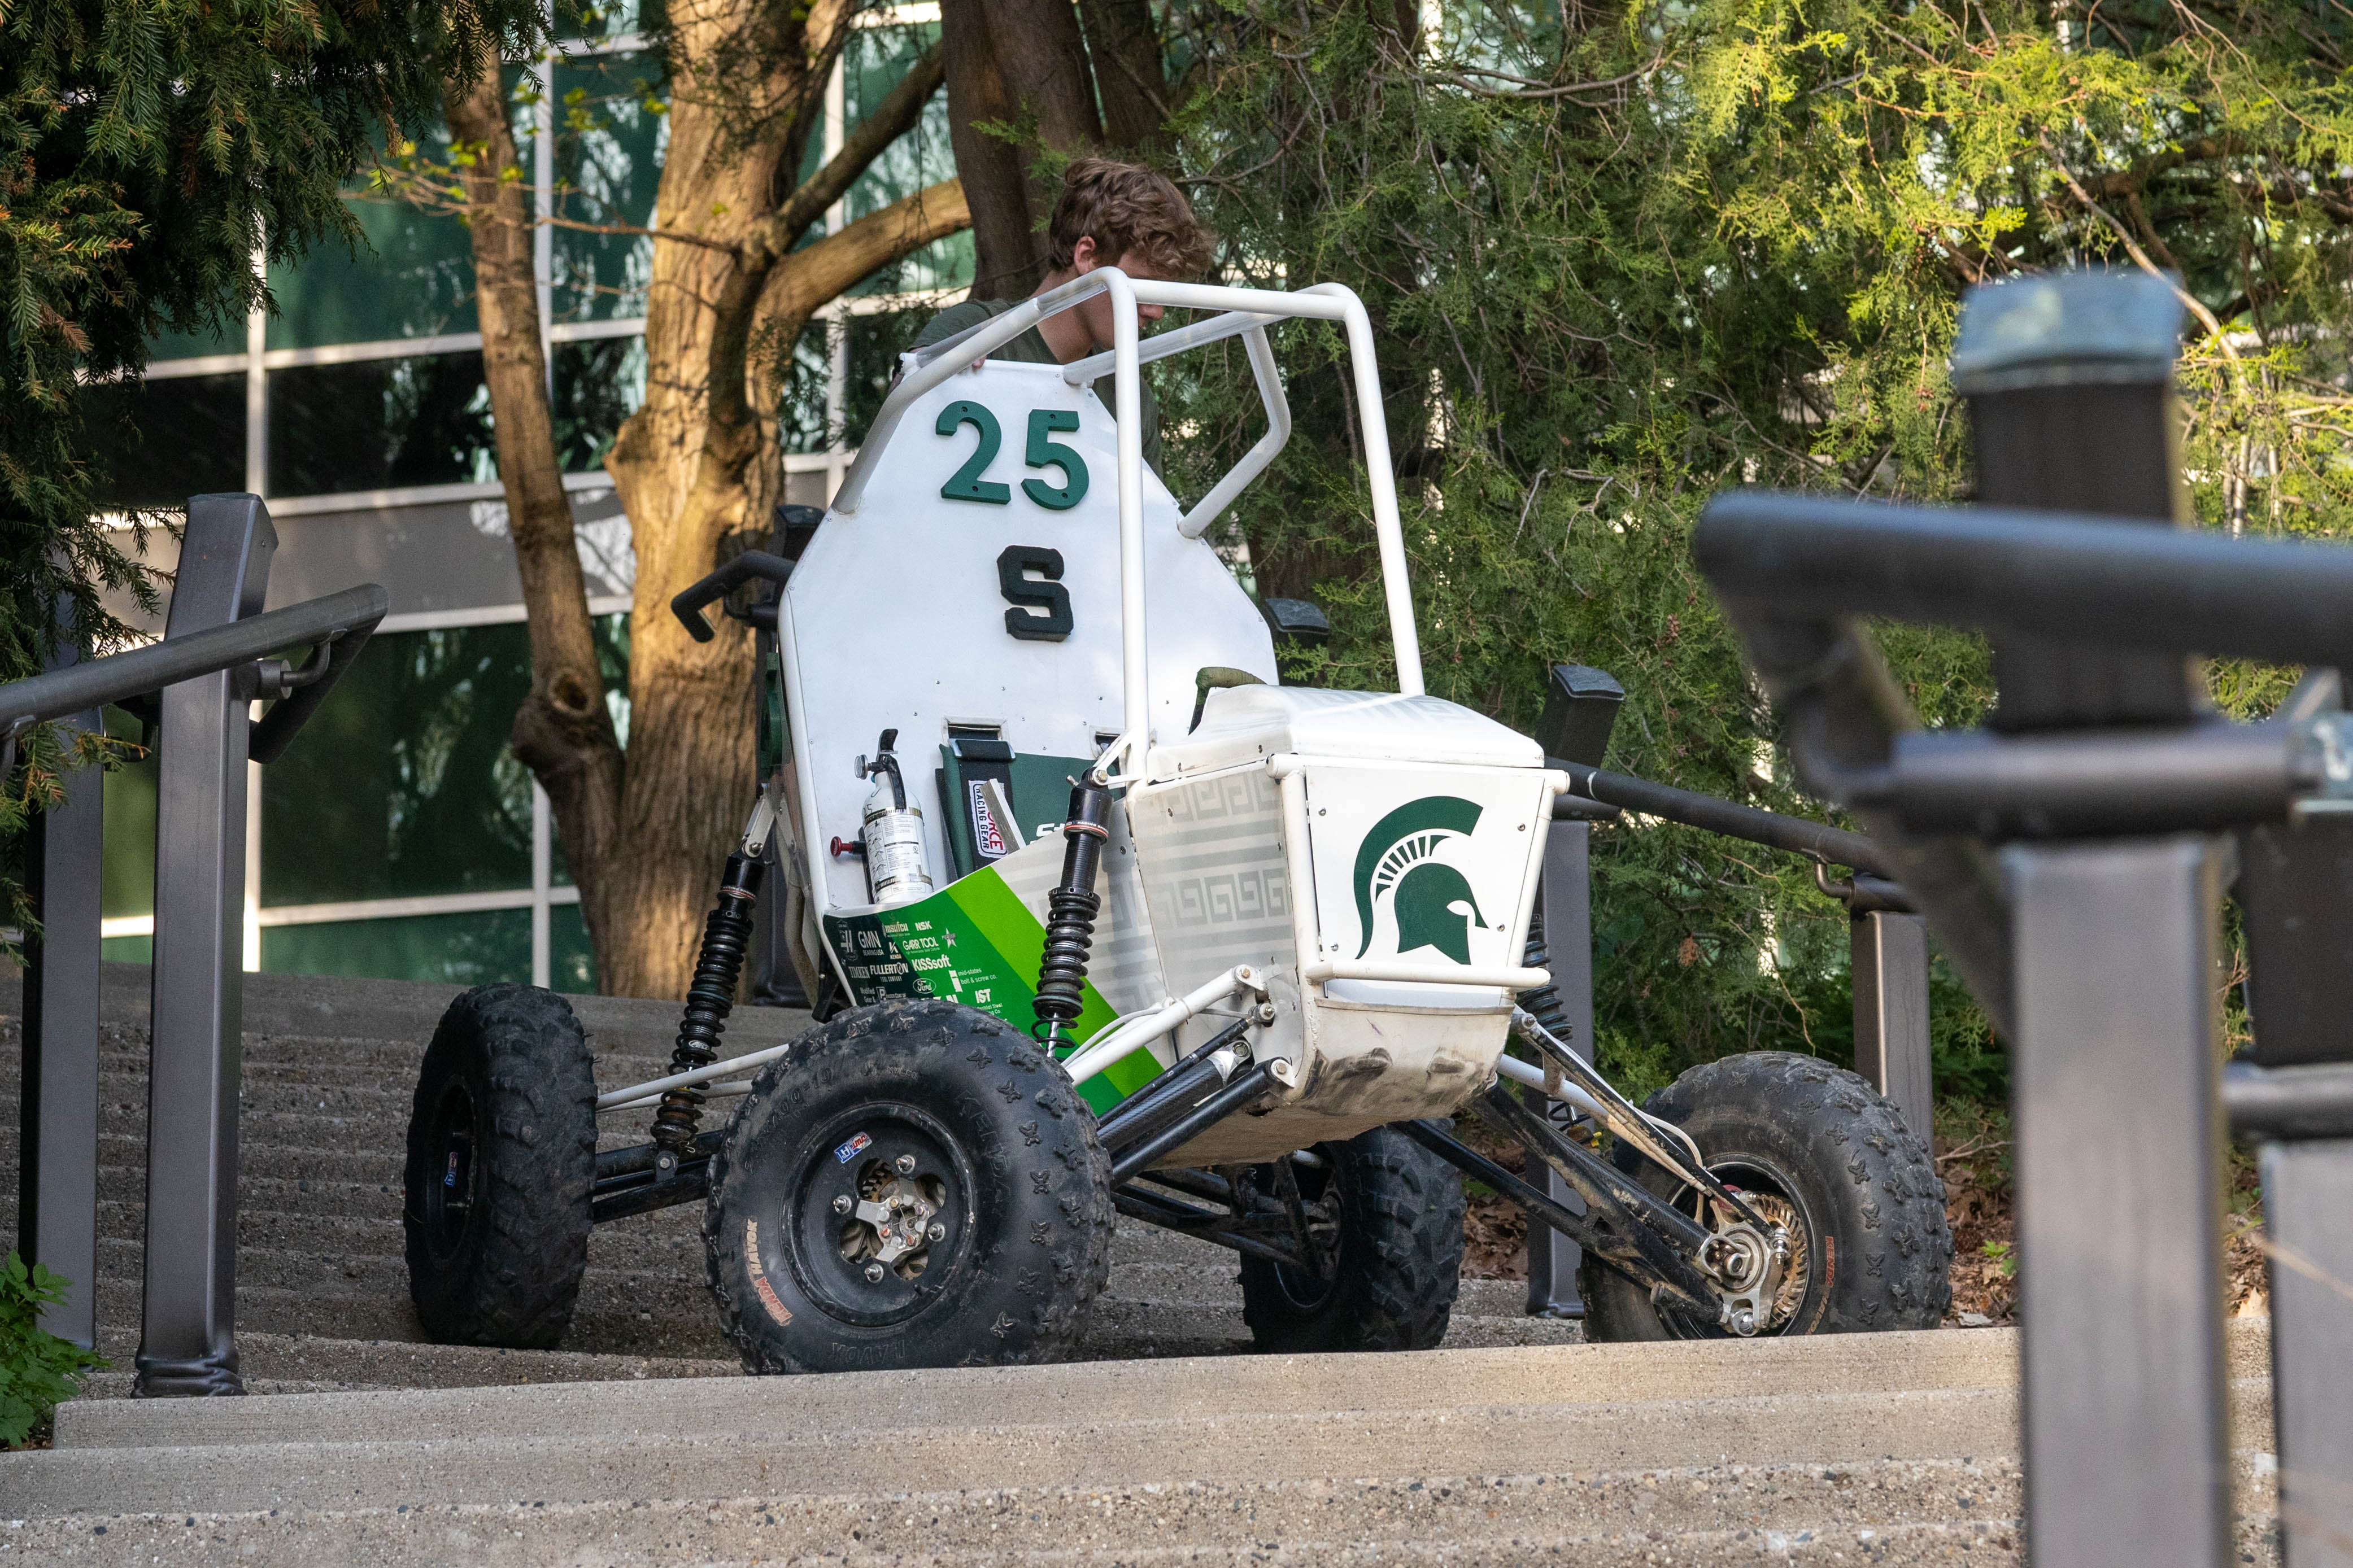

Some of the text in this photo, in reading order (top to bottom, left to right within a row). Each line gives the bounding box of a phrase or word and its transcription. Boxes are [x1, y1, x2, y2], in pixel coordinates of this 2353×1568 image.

[935, 400, 1090, 510] 25
[996, 545, 1074, 642] S
[981, 824, 990, 849] GEAR
[914, 920, 933, 931] NSK
[858, 931, 881, 949] GMN
[902, 939, 921, 951] GARR
[919, 936, 939, 949] TOOL
[870, 962, 909, 975] FULLERTON
[911, 954, 952, 972] KISSsoft
[958, 967, 982, 976] mid-states
[848, 966, 870, 979] TIMKEN
[917, 980, 933, 992] Ford
[974, 988, 991, 1004] IST
[746, 1218, 764, 1275] HAVOK
[1825, 1235, 1835, 1288] KENDA
